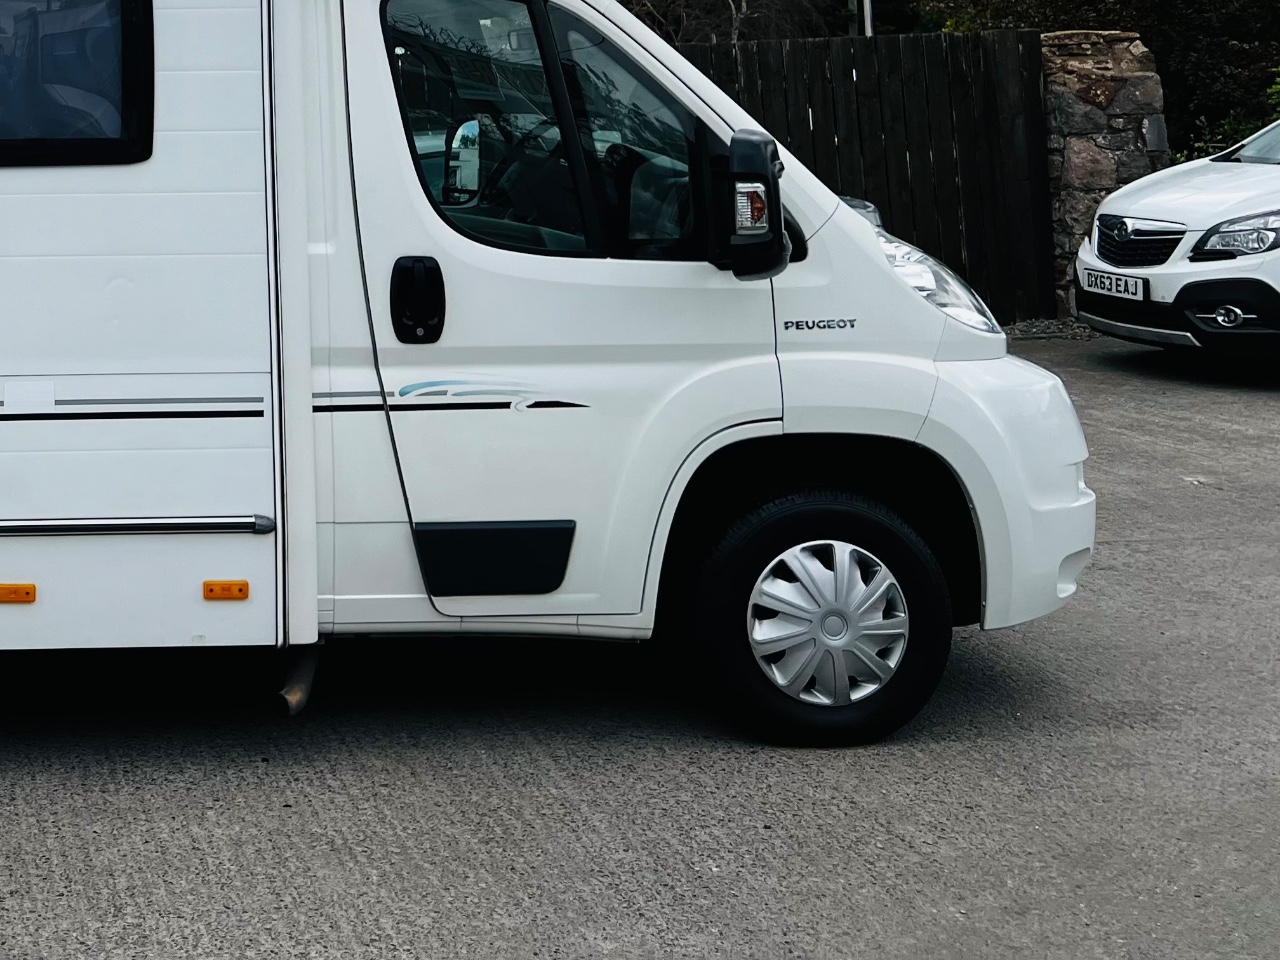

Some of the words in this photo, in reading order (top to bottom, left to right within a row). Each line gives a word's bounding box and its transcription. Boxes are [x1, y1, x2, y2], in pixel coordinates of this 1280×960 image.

[1087, 272, 1113, 292] DX63
[1115, 277, 1138, 296] EAJ
[783, 318, 857, 331] PEUGEOT
